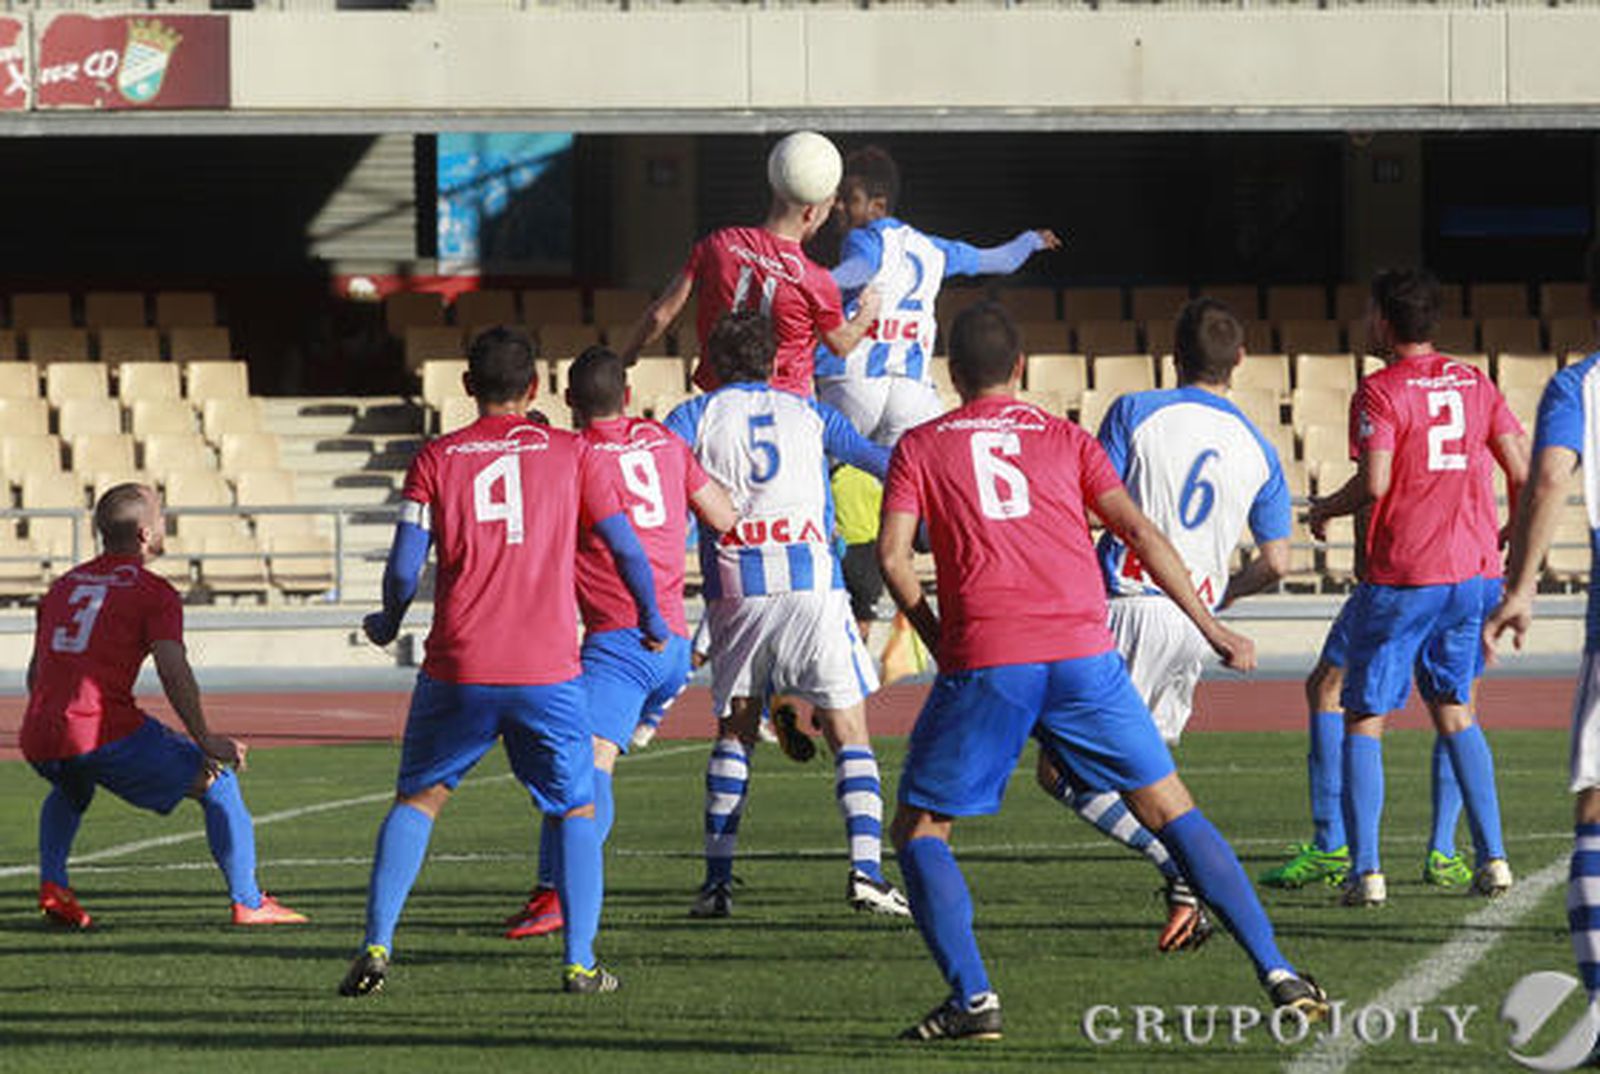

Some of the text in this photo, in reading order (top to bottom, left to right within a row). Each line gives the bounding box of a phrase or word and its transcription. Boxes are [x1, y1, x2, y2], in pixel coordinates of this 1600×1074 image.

[898, 251, 924, 311] 2
[747, 413, 780, 484] 5
[1428, 389, 1468, 471] 2
[473, 453, 524, 545] 4
[618, 450, 667, 528] 9
[970, 431, 1031, 520] 6
[1178, 449, 1220, 530] 6
[52, 584, 109, 652] 3
